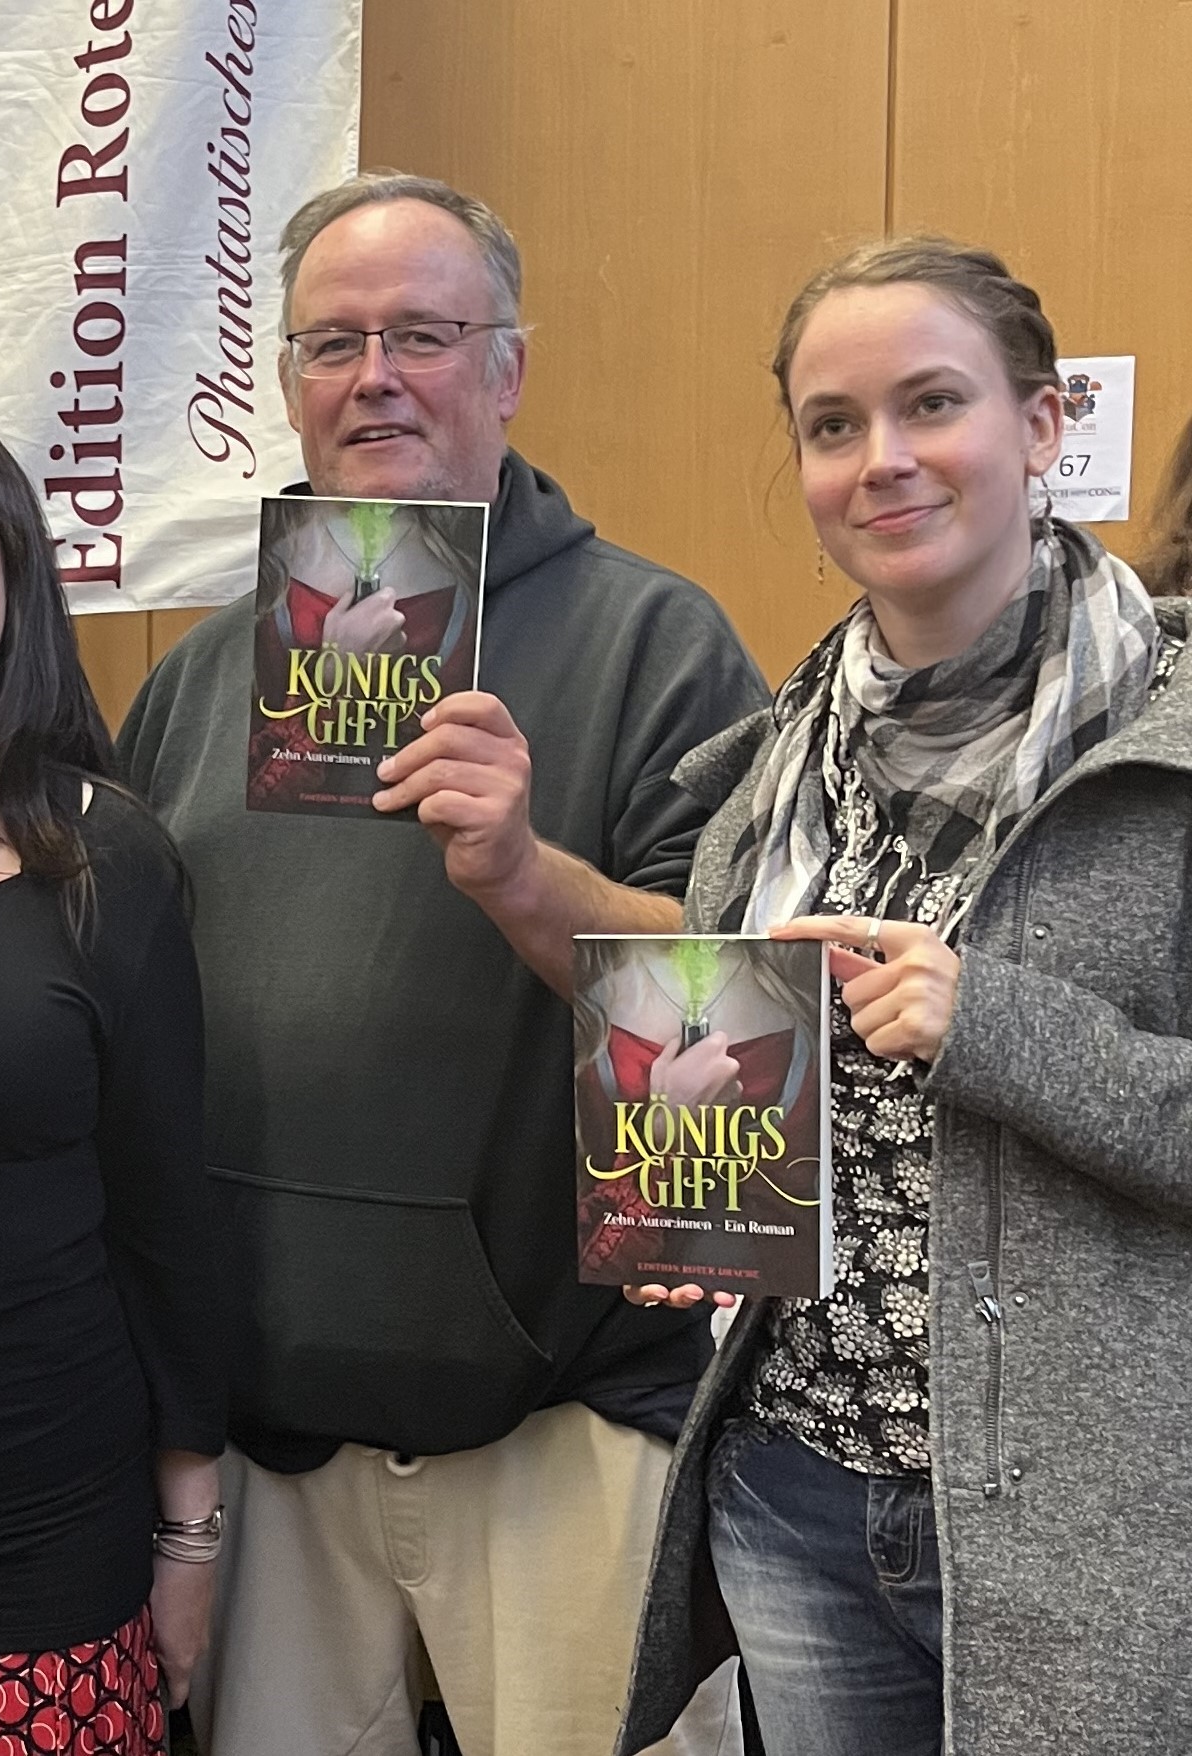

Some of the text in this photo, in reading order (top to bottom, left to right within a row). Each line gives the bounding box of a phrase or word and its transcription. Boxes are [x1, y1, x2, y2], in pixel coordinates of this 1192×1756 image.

[187, 0, 259, 480] Phantastisches
[44, 0, 135, 590] Edition Rote
[1059, 454, 1092, 478] 67
[282, 642, 443, 709] KÖNIGS
[308, 699, 408, 749] GIFT
[272, 748, 302, 762] Zehn
[305, 750, 371, 766] Autor:innen
[611, 1094, 787, 1164] KÖNIGS
[639, 1156, 750, 1212] GIFT
[603, 1211, 635, 1227] Zehn
[637, 1215, 713, 1232] Autor:innen
[724, 1218, 746, 1234] Ein
[748, 1221, 795, 1237] Roman
